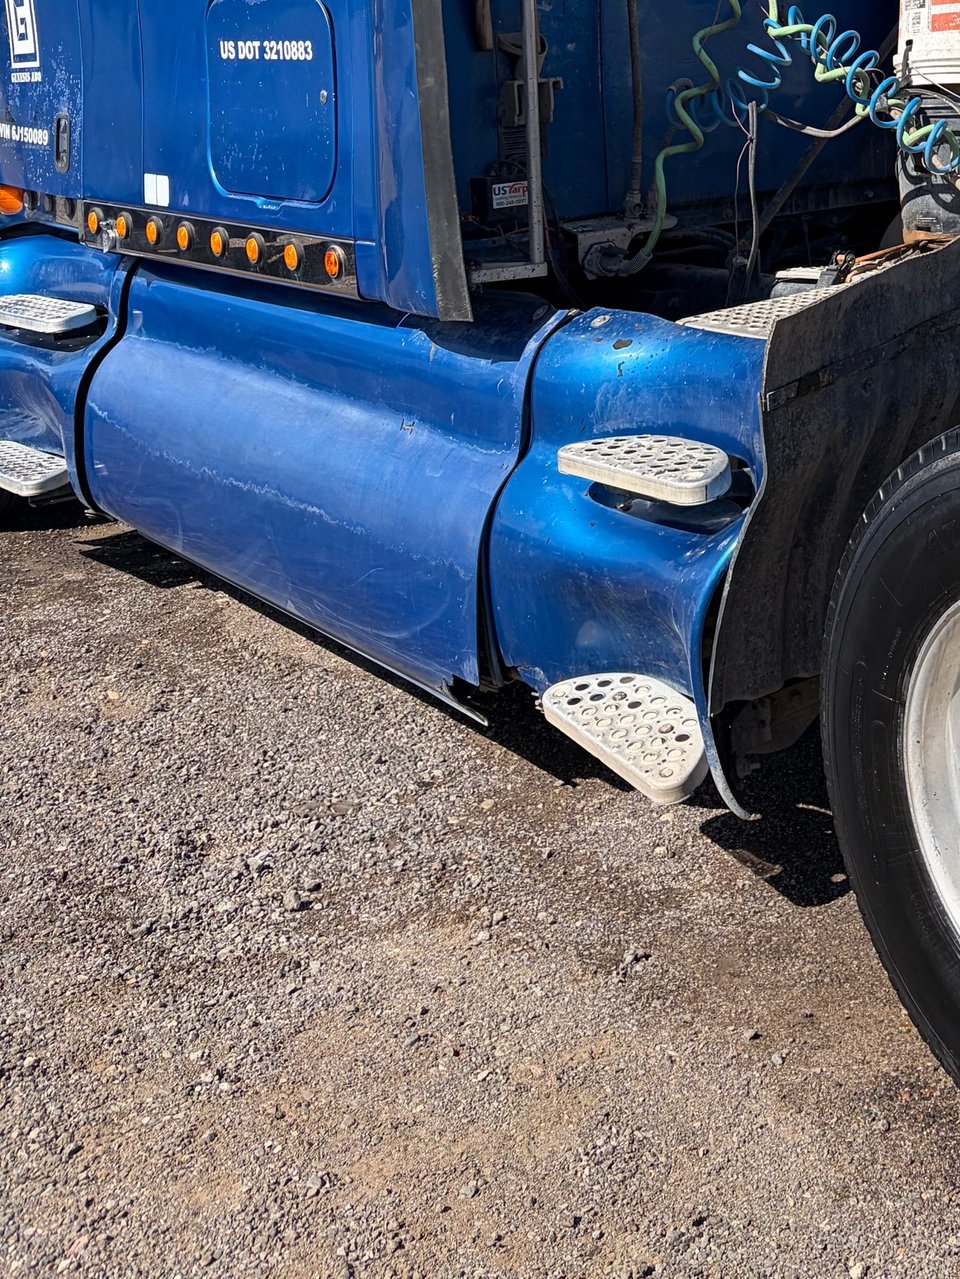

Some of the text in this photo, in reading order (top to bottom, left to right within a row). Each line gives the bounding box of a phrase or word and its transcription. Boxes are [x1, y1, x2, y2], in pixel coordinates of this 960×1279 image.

[220, 40, 313, 60] US DOT 3210883
